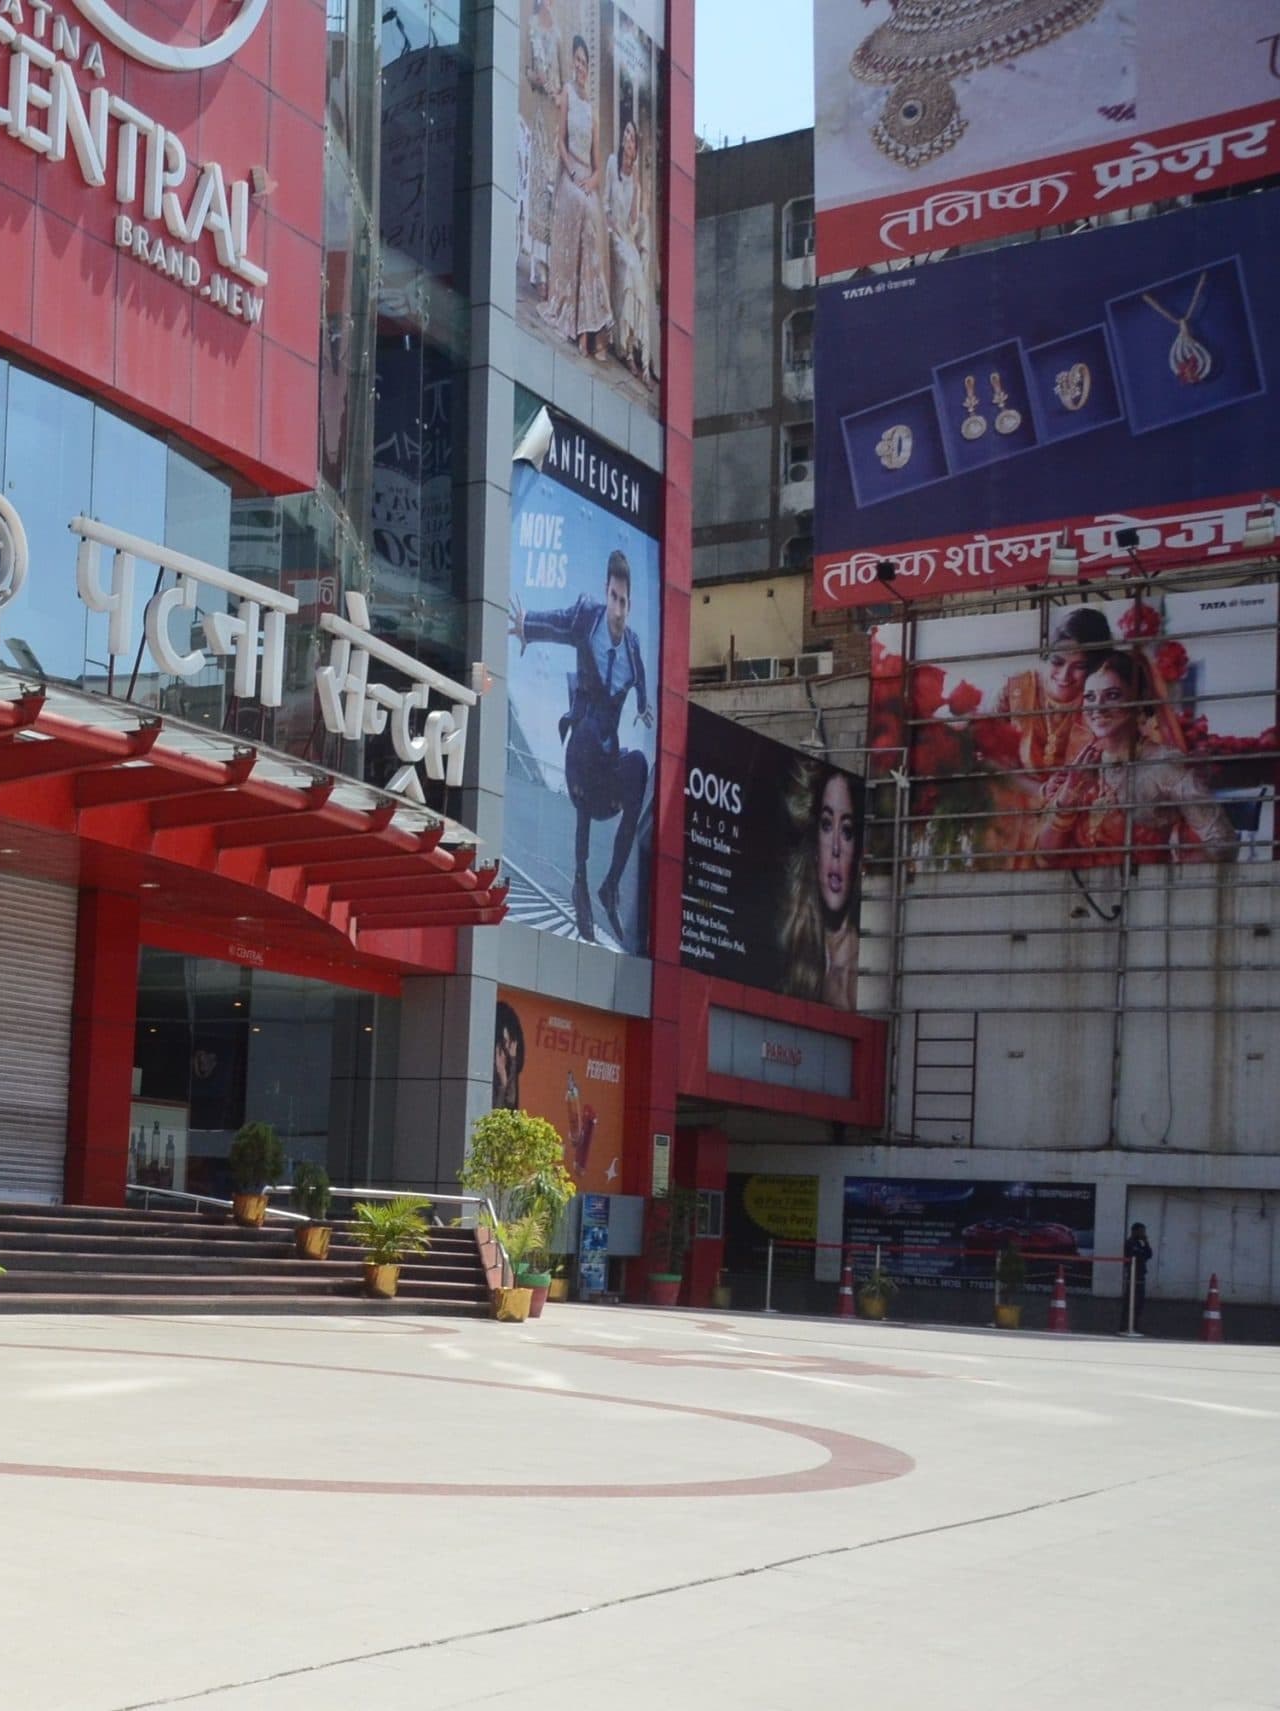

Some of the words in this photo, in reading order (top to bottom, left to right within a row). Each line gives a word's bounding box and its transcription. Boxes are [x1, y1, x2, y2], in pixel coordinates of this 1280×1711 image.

[0, 0, 105, 79] ATNA
[879, 171, 1077, 251] तनिष्क
[1092, 119, 1276, 199] फ्रेज़र
[842, 286, 873, 300] TATA
[548, 435, 640, 515] ANHEUSEN
[520, 512, 564, 550] MOVE
[944, 532, 1064, 577] शोरूम
[1074, 501, 1280, 564] फ्रेज़
[526, 552, 568, 588] LABS
[67, 515, 299, 708] पटना
[1200, 600, 1227, 610] TATA
[684, 767, 741, 815] OOKS
[692, 810, 739, 839] ALON
